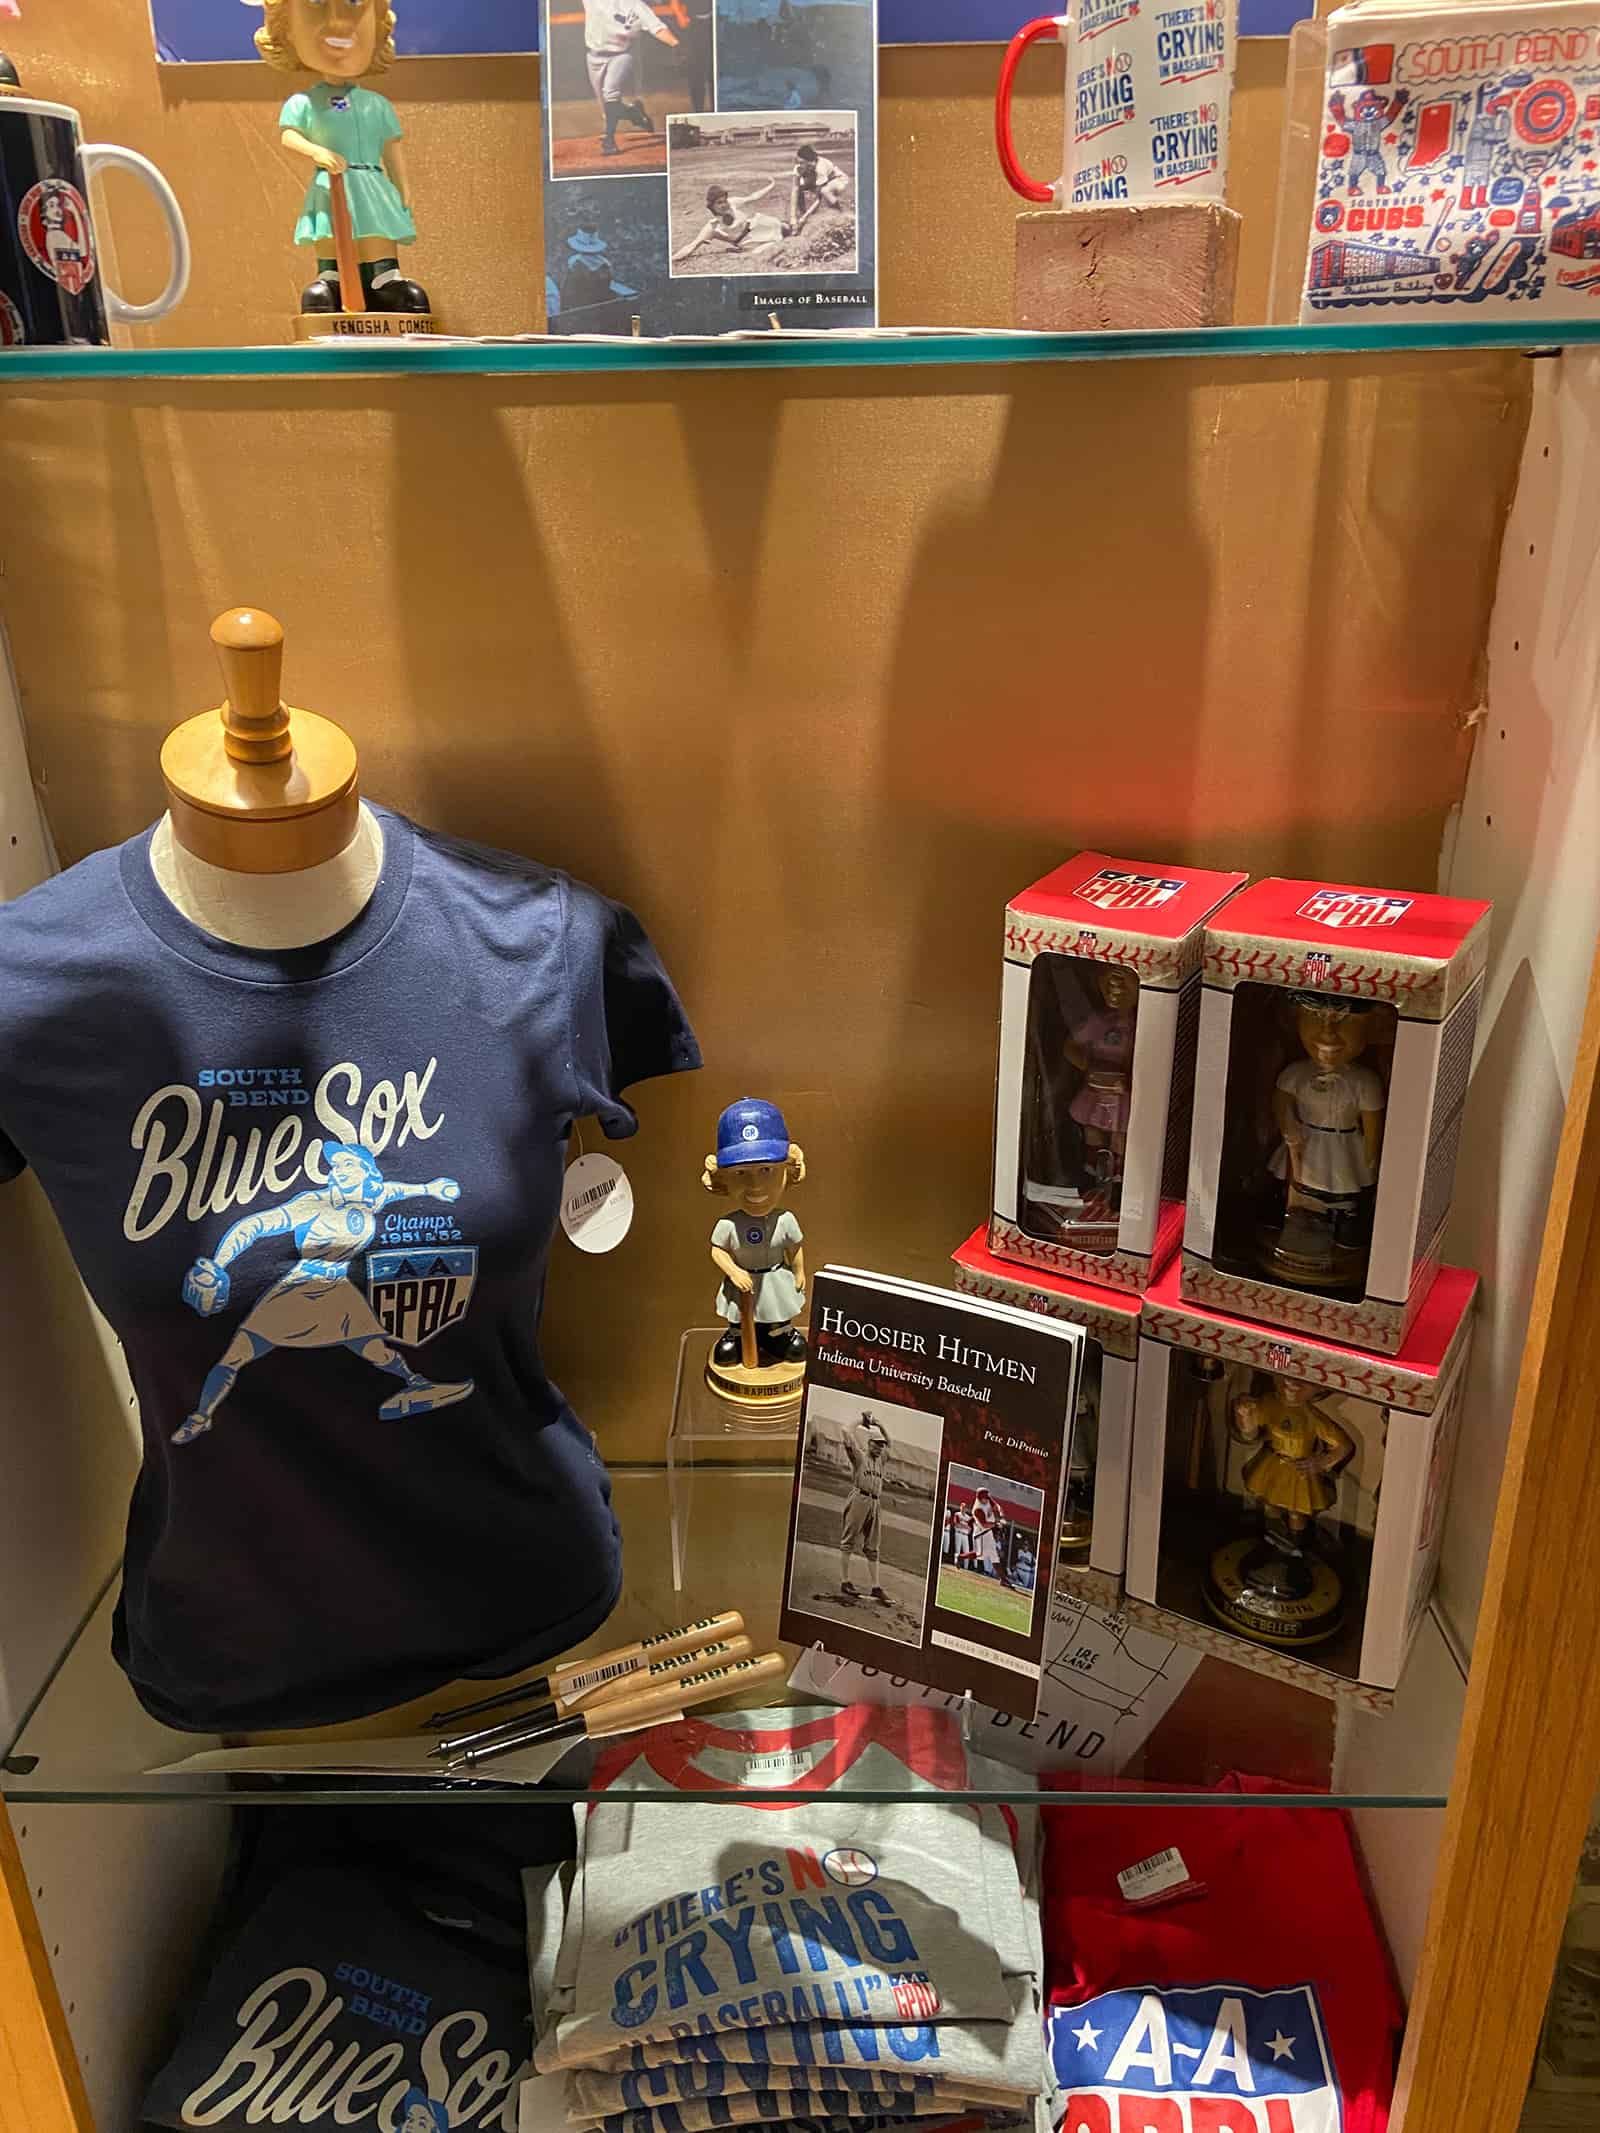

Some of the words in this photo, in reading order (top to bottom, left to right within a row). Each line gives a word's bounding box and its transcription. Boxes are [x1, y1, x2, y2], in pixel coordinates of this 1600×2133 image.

[1157, 22, 1225, 61] CRYING
[1408, 41, 1505, 79] SOUTH
[1515, 33, 1589, 65] BEND
[1076, 64, 1105, 88] HERE'S
[1151, 124, 1218, 164] CRYING
[1073, 164, 1101, 188] HERE'S
[1153, 167, 1165, 180] IN
[1345, 205, 1425, 232] CUBS
[753, 294, 794, 306] IMAGES
[797, 295, 812, 305] OF
[815, 292, 869, 305] BASEBALL
[332, 319, 391, 335] KENOSHA
[398, 319, 434, 335] COMETS
[198, 1068, 303, 1088] SOUTH
[229, 1088, 311, 1107] BEND
[744, 1127, 756, 1138] GR
[122, 1083, 302, 1242] Blue
[303, 1056, 445, 1185] Sox
[384, 1213, 455, 1234] Champs
[380, 1231, 422, 1245] 1951
[819, 1306, 928, 1356] HOOSIER
[936, 1333, 1038, 1386] HITMEN
[817, 1346, 865, 1371] Indiana
[868, 1357, 934, 1389] University
[937, 1375, 992, 1403] Baseball
[983, 1429, 1004, 1445] Pete
[1062, 1654, 1093, 1671] LAND
[1074, 1647, 1101, 1666] IRE
[614, 1860, 785, 1957] "THERE'S
[611, 1888, 920, 2029] CRYING
[334, 1962, 432, 2015] SOUTH
[349, 1996, 427, 2037] BEND
[181, 1967, 405, 2127] Blue
